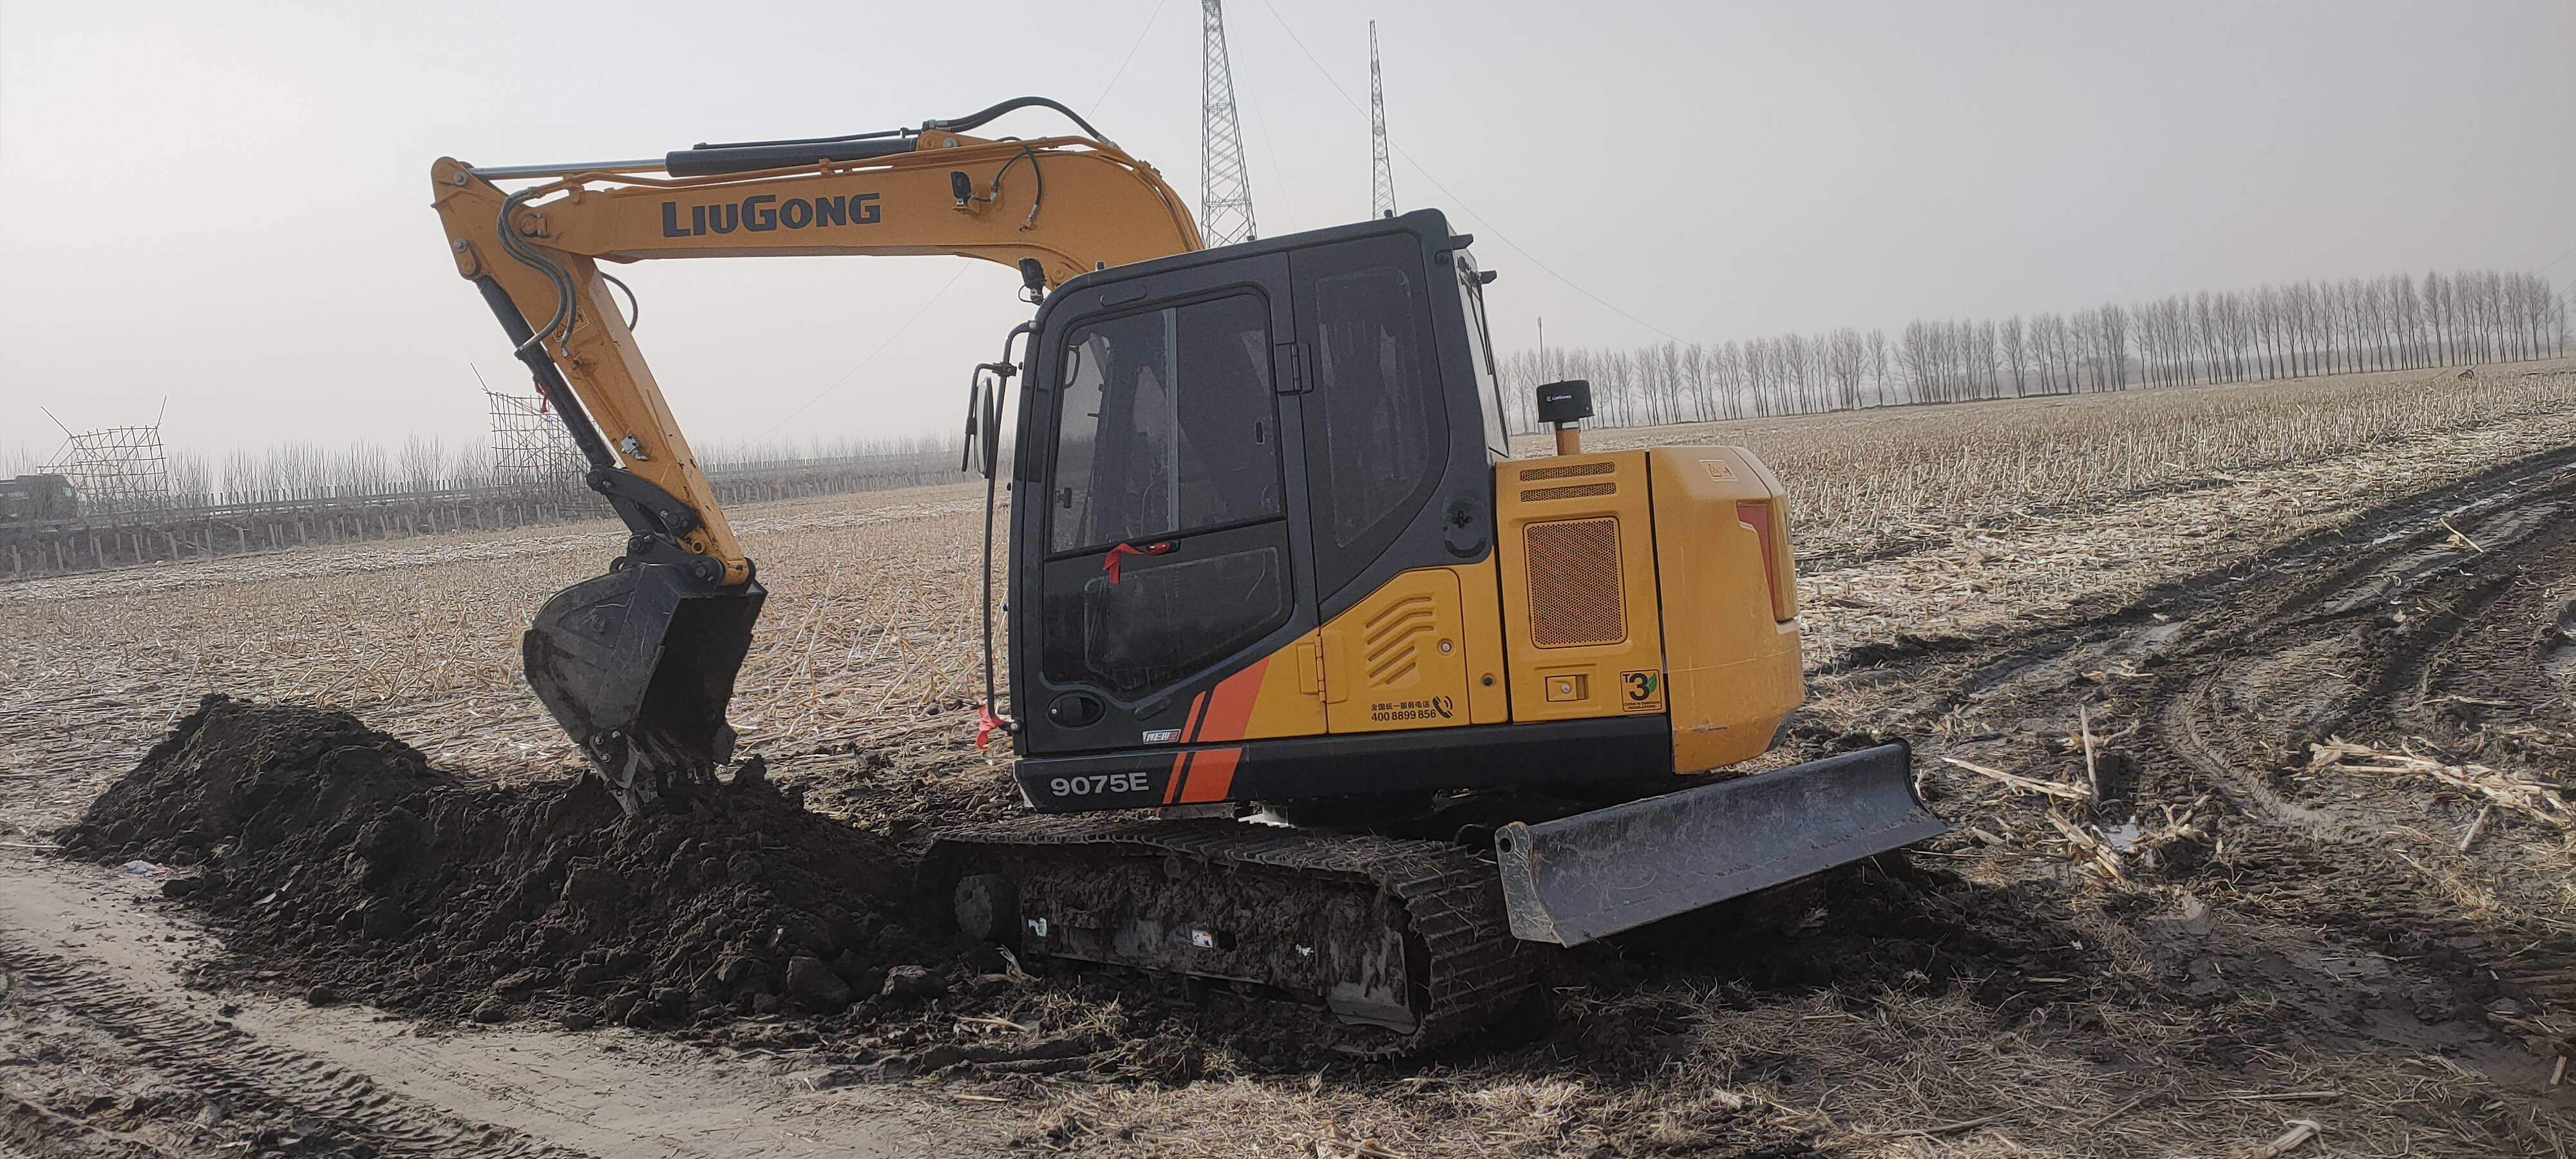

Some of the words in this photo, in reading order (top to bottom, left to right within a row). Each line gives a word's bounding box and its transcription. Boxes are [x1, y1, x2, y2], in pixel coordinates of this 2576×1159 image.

[1372, 712, 1390, 722] 400
[1392, 711, 1416, 721] 8899
[1418, 710, 1437, 719] 856
[1050, 772, 1150, 796] 9075E
